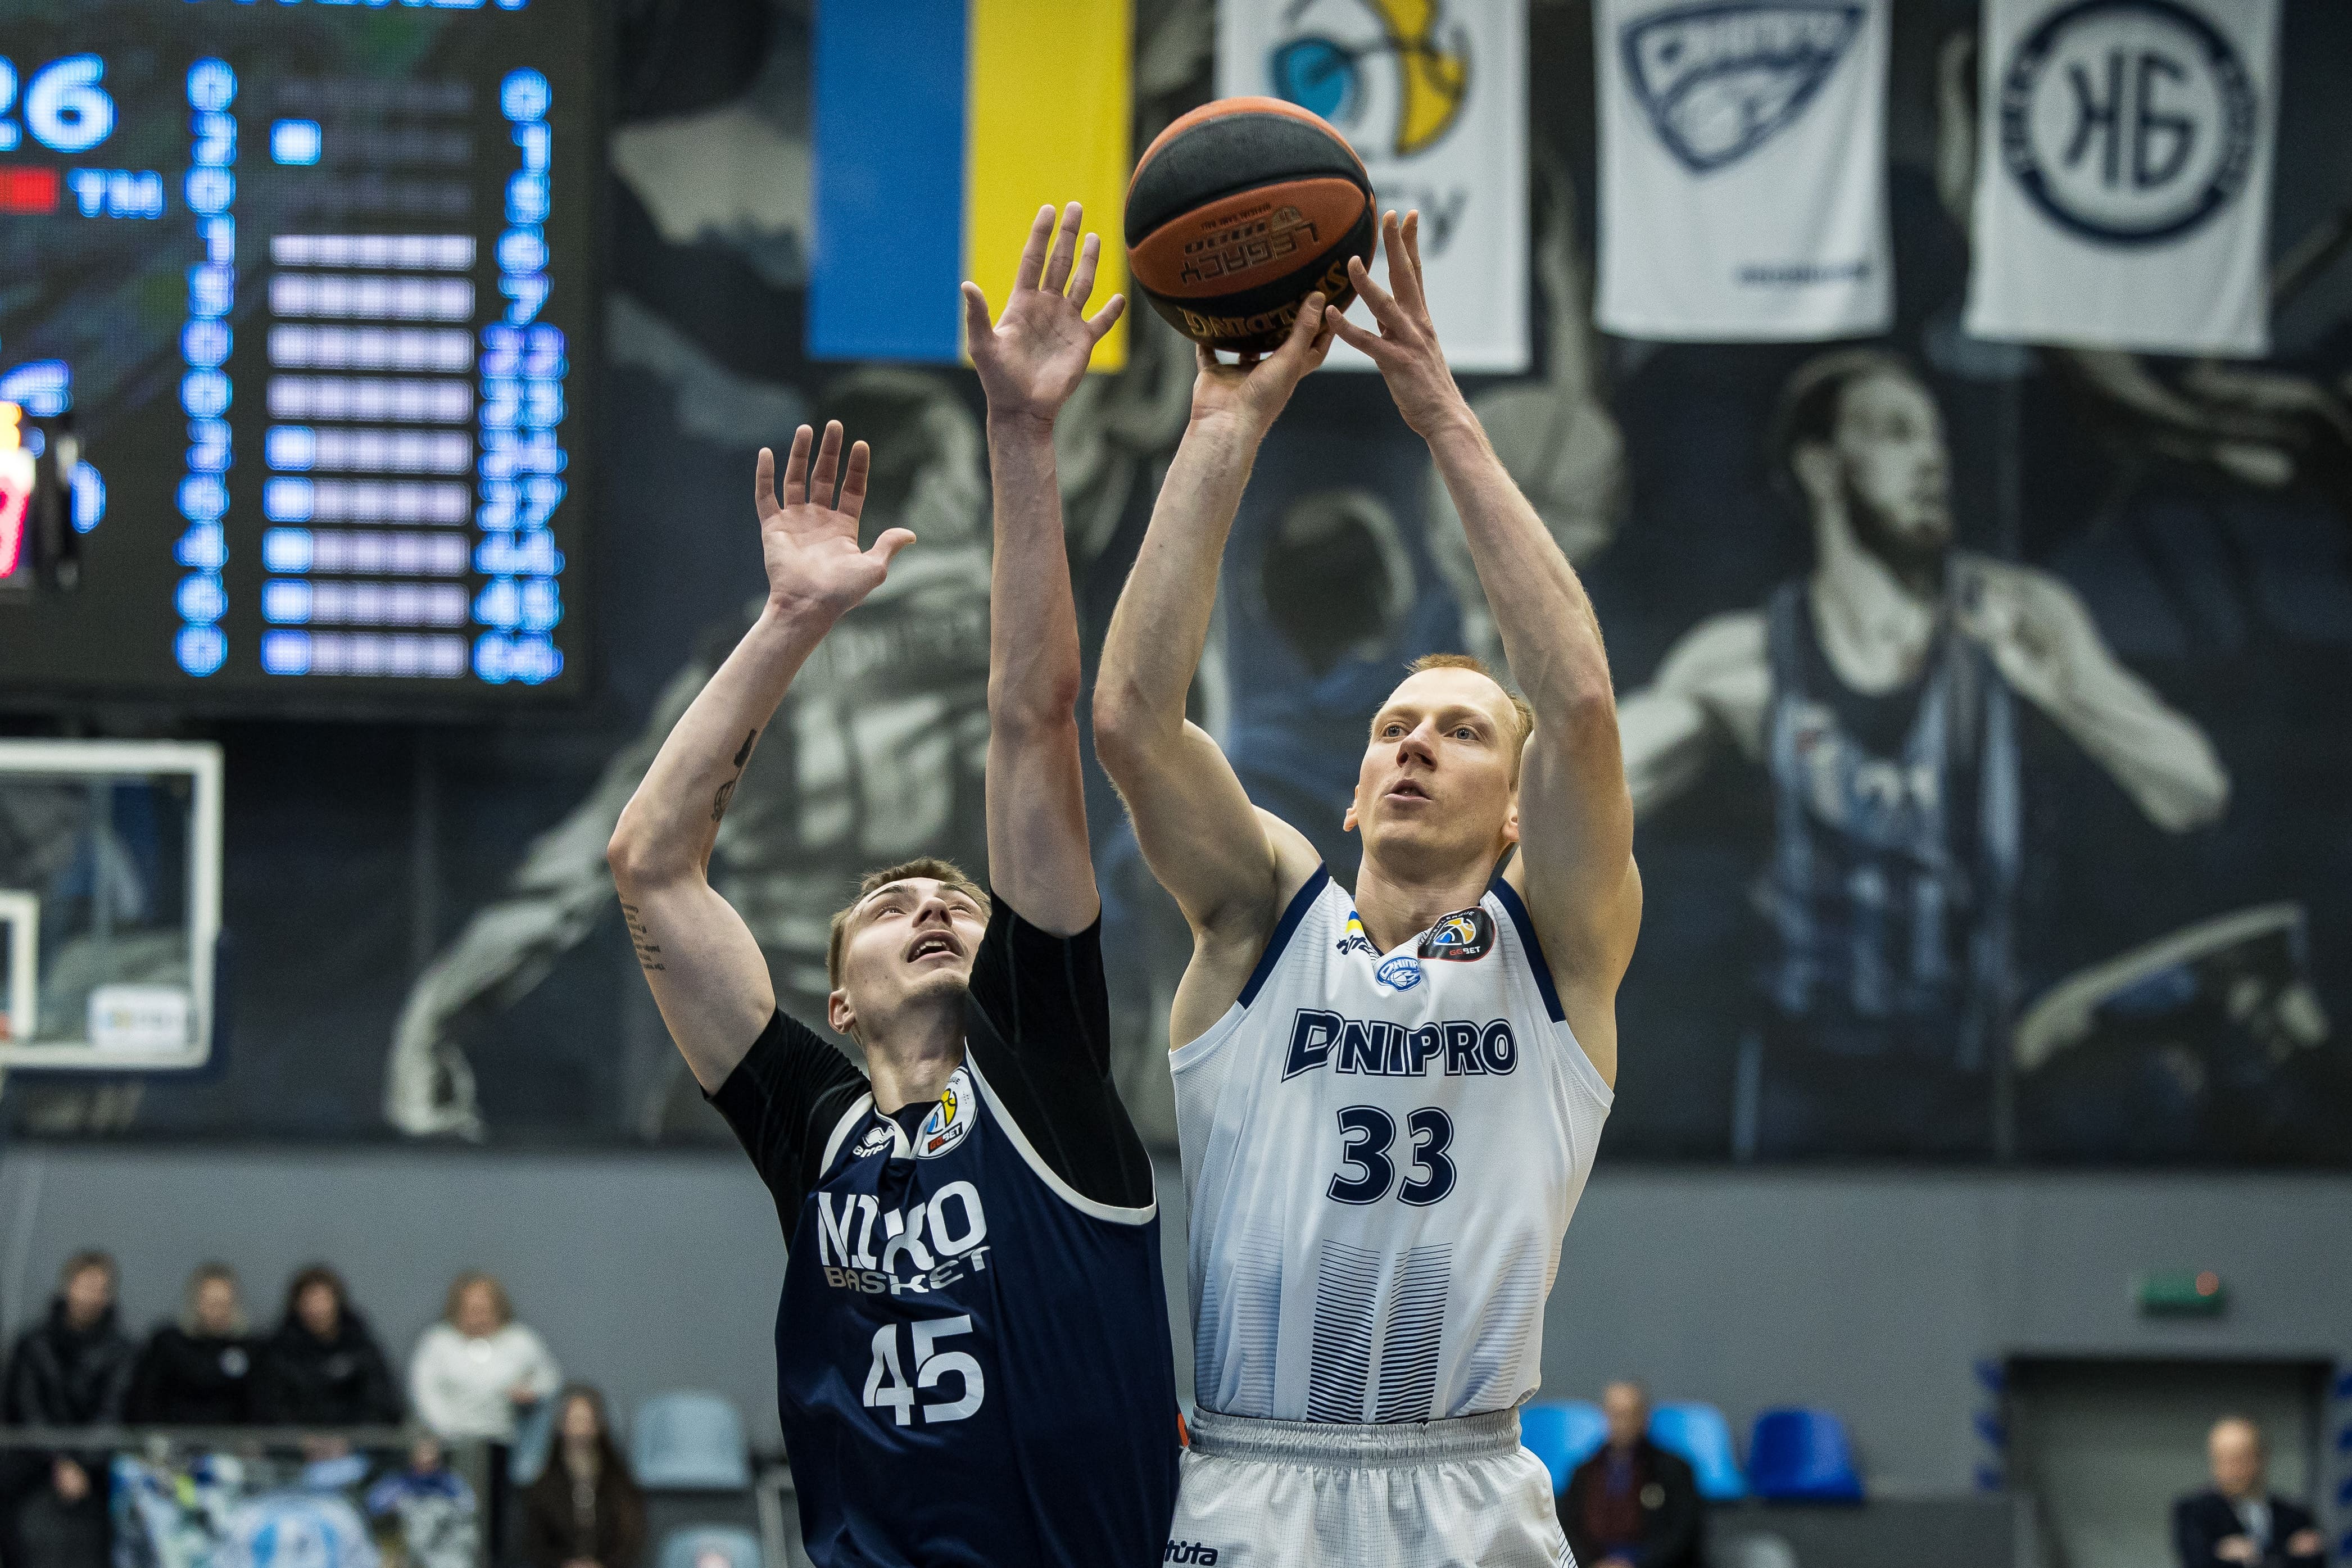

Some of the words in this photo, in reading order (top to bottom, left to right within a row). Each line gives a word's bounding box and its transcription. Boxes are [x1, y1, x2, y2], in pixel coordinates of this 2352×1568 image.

[1180, 221, 1319, 284] LEGACY
[1281, 1008, 1518, 1083] DNIPRO
[1326, 1104, 1457, 1207] 33
[818, 1181, 987, 1274] NIKO
[823, 1246, 991, 1295] BASKET
[863, 1315, 984, 1426] 45
